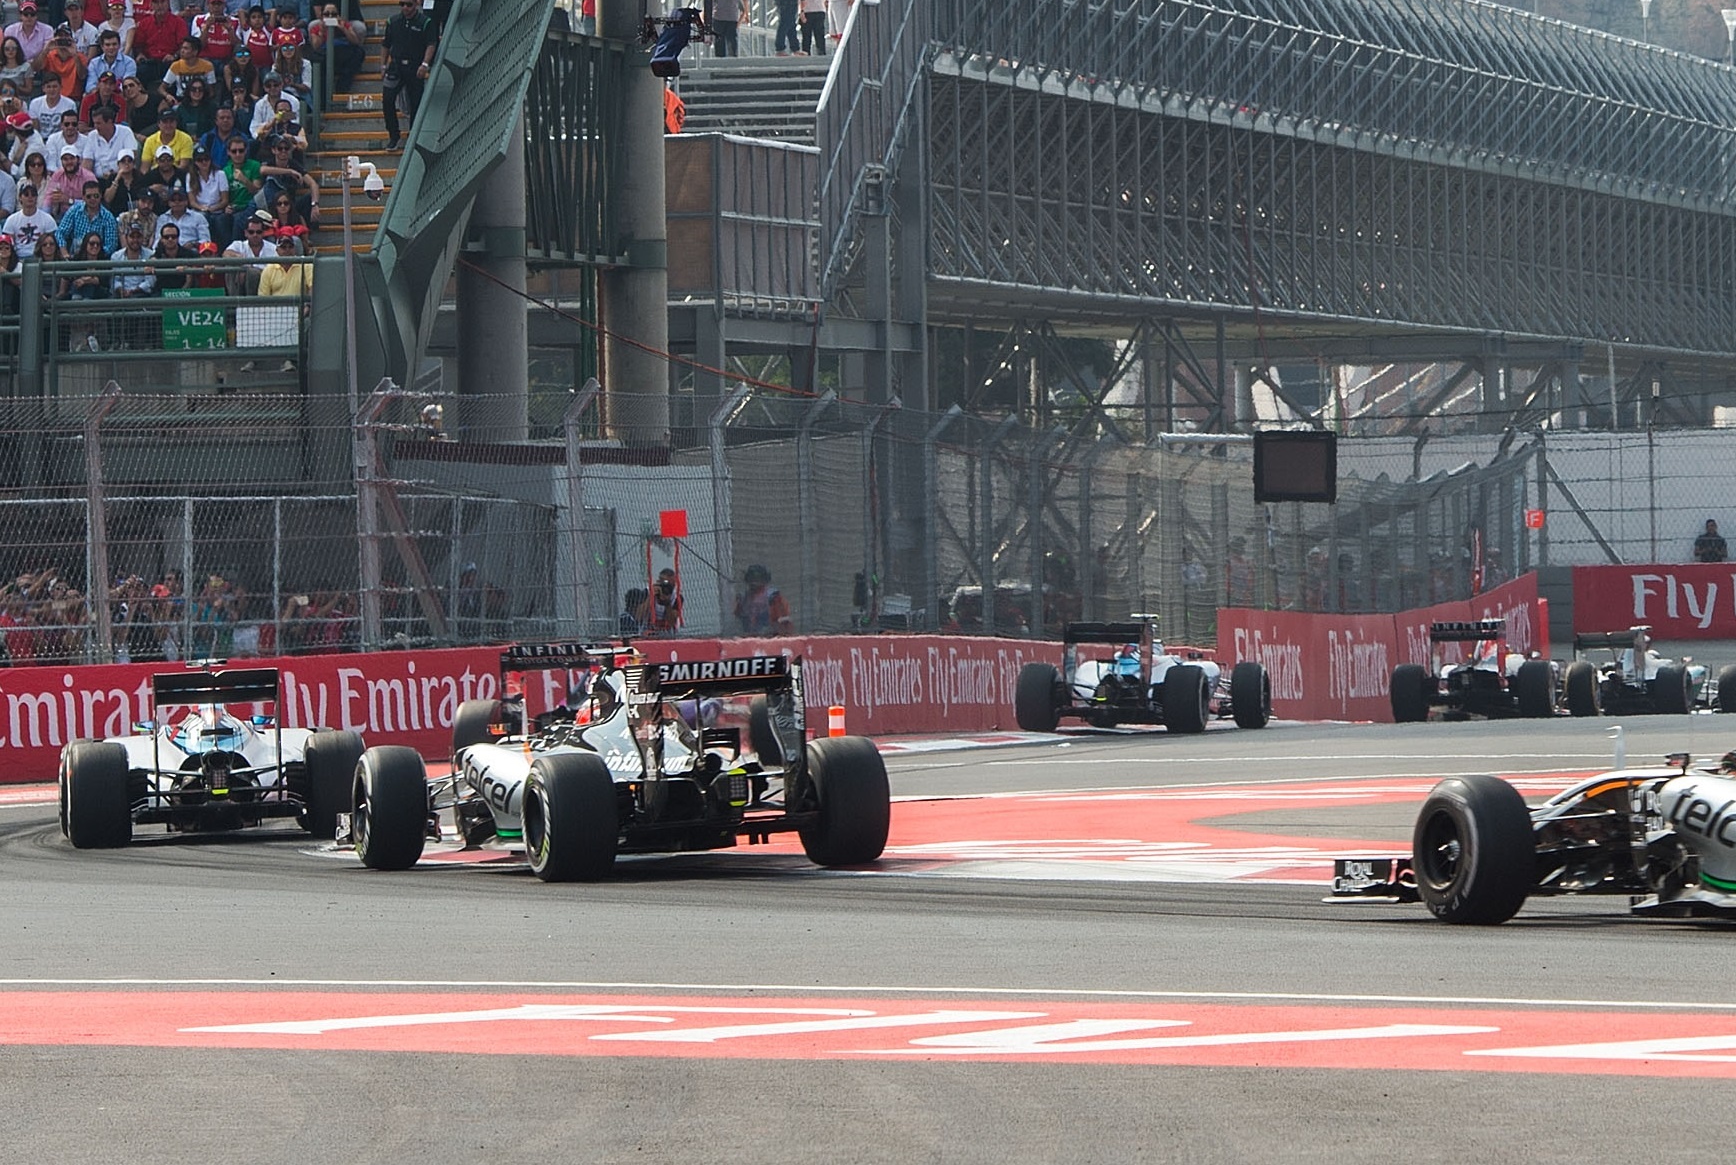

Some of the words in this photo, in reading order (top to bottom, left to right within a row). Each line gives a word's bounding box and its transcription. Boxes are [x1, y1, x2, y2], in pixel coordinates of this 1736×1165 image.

[178, 310, 225, 326] VE24
[207, 337, 225, 350] 14
[1631, 573, 1717, 628] Fly
[659, 657, 777, 682] SMIRNOFF
[872, 643, 922, 706] Emirates
[949, 644, 996, 706] Emirates
[337, 661, 501, 733] Emirate
[176, 1003, 1502, 1055] Fly
